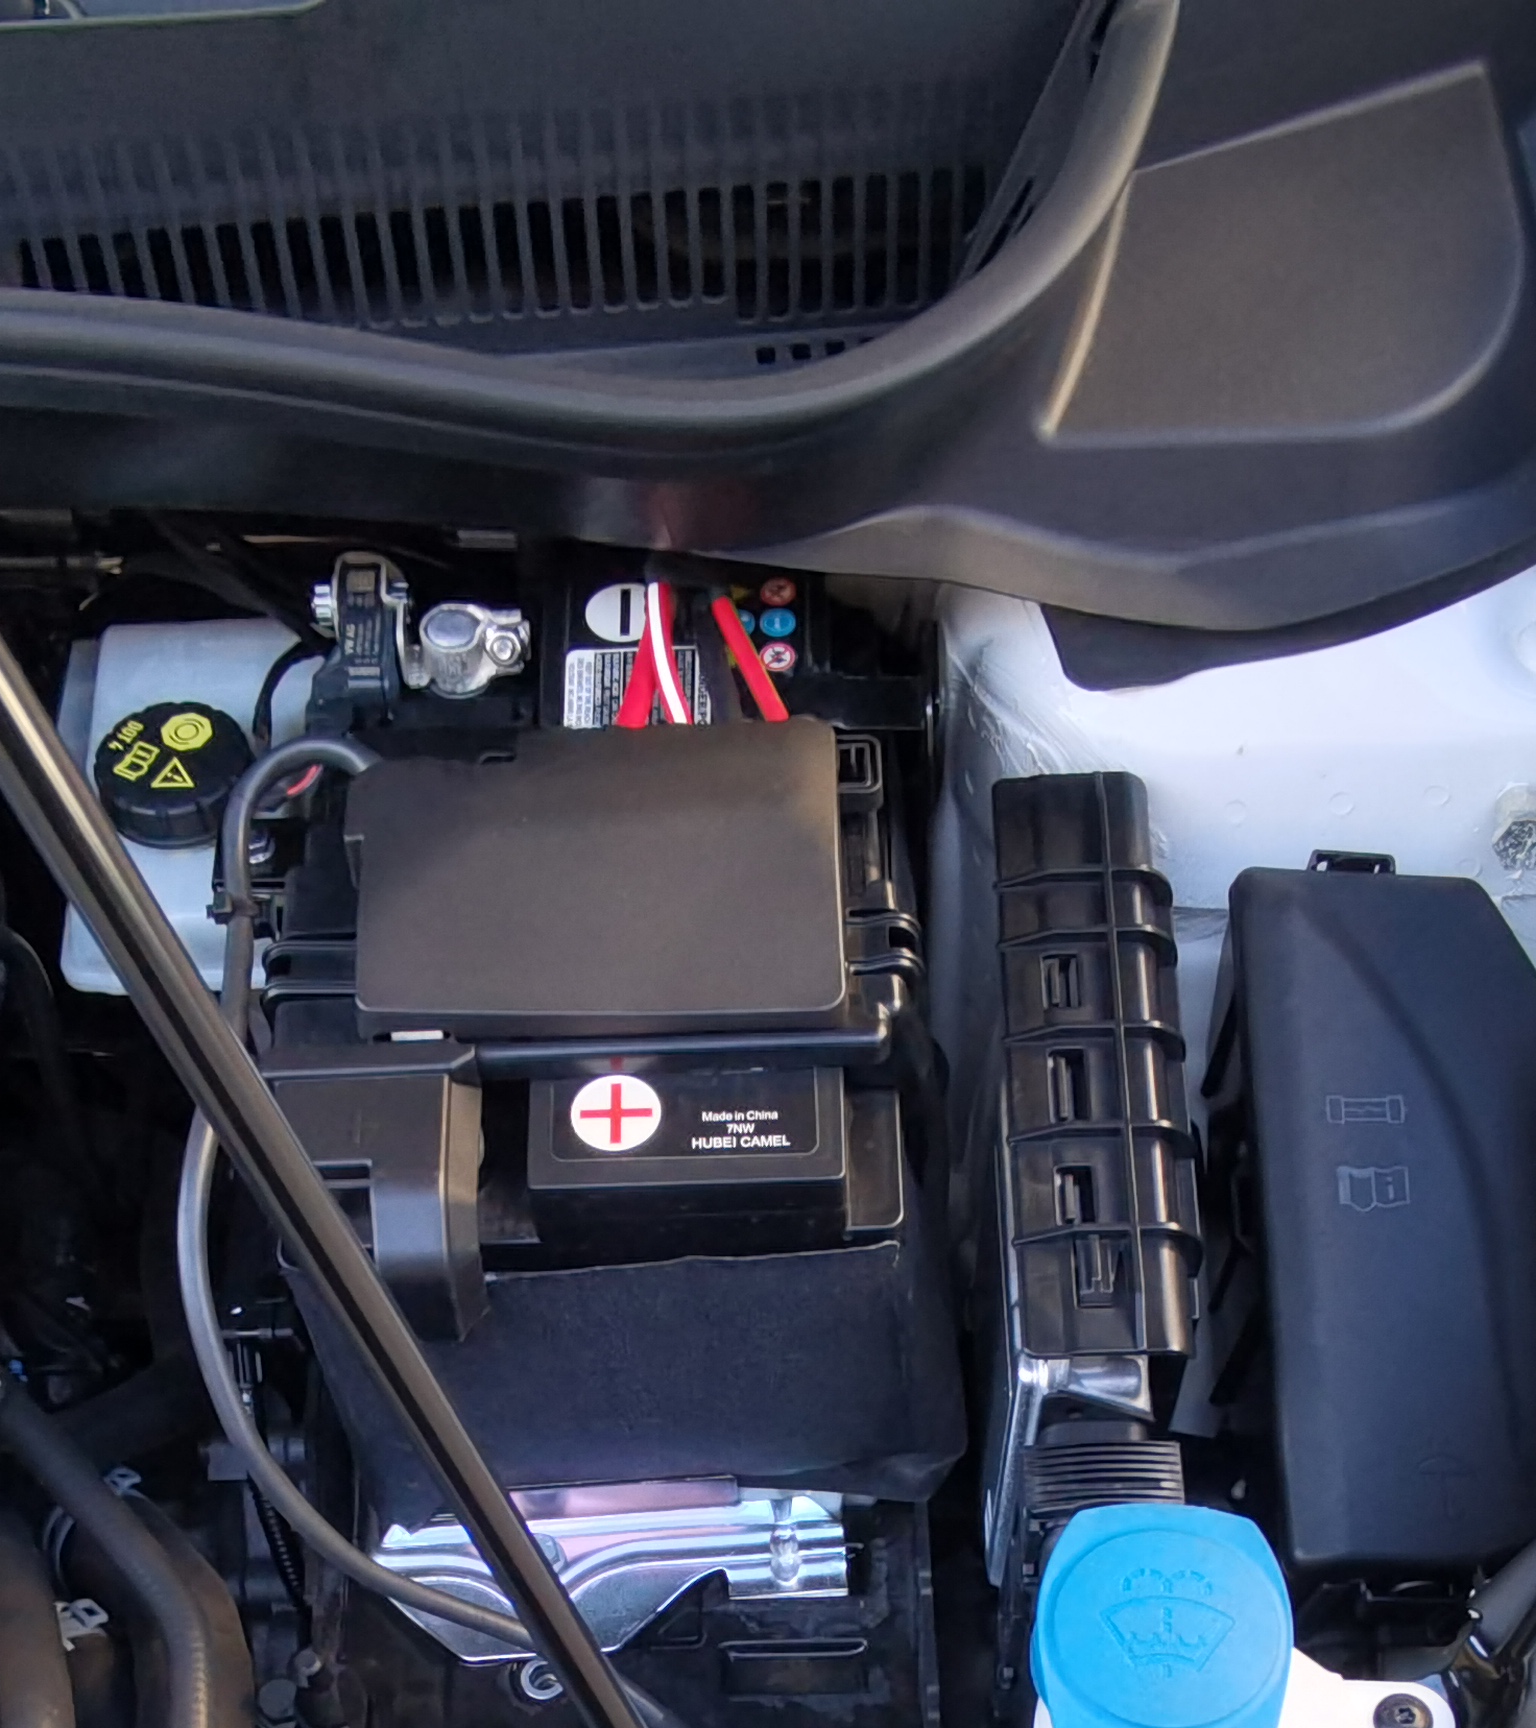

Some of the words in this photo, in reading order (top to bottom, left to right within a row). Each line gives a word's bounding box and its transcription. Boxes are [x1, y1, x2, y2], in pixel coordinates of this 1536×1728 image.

[117, 719, 145, 744] DOT
[701, 1110, 733, 1122] Made
[734, 1110, 745, 1121] in
[746, 1110, 779, 1121] China
[726, 1122, 755, 1134] 7NW
[691, 1136, 737, 1149] HUBEI
[740, 1134, 791, 1148] CAMEL
